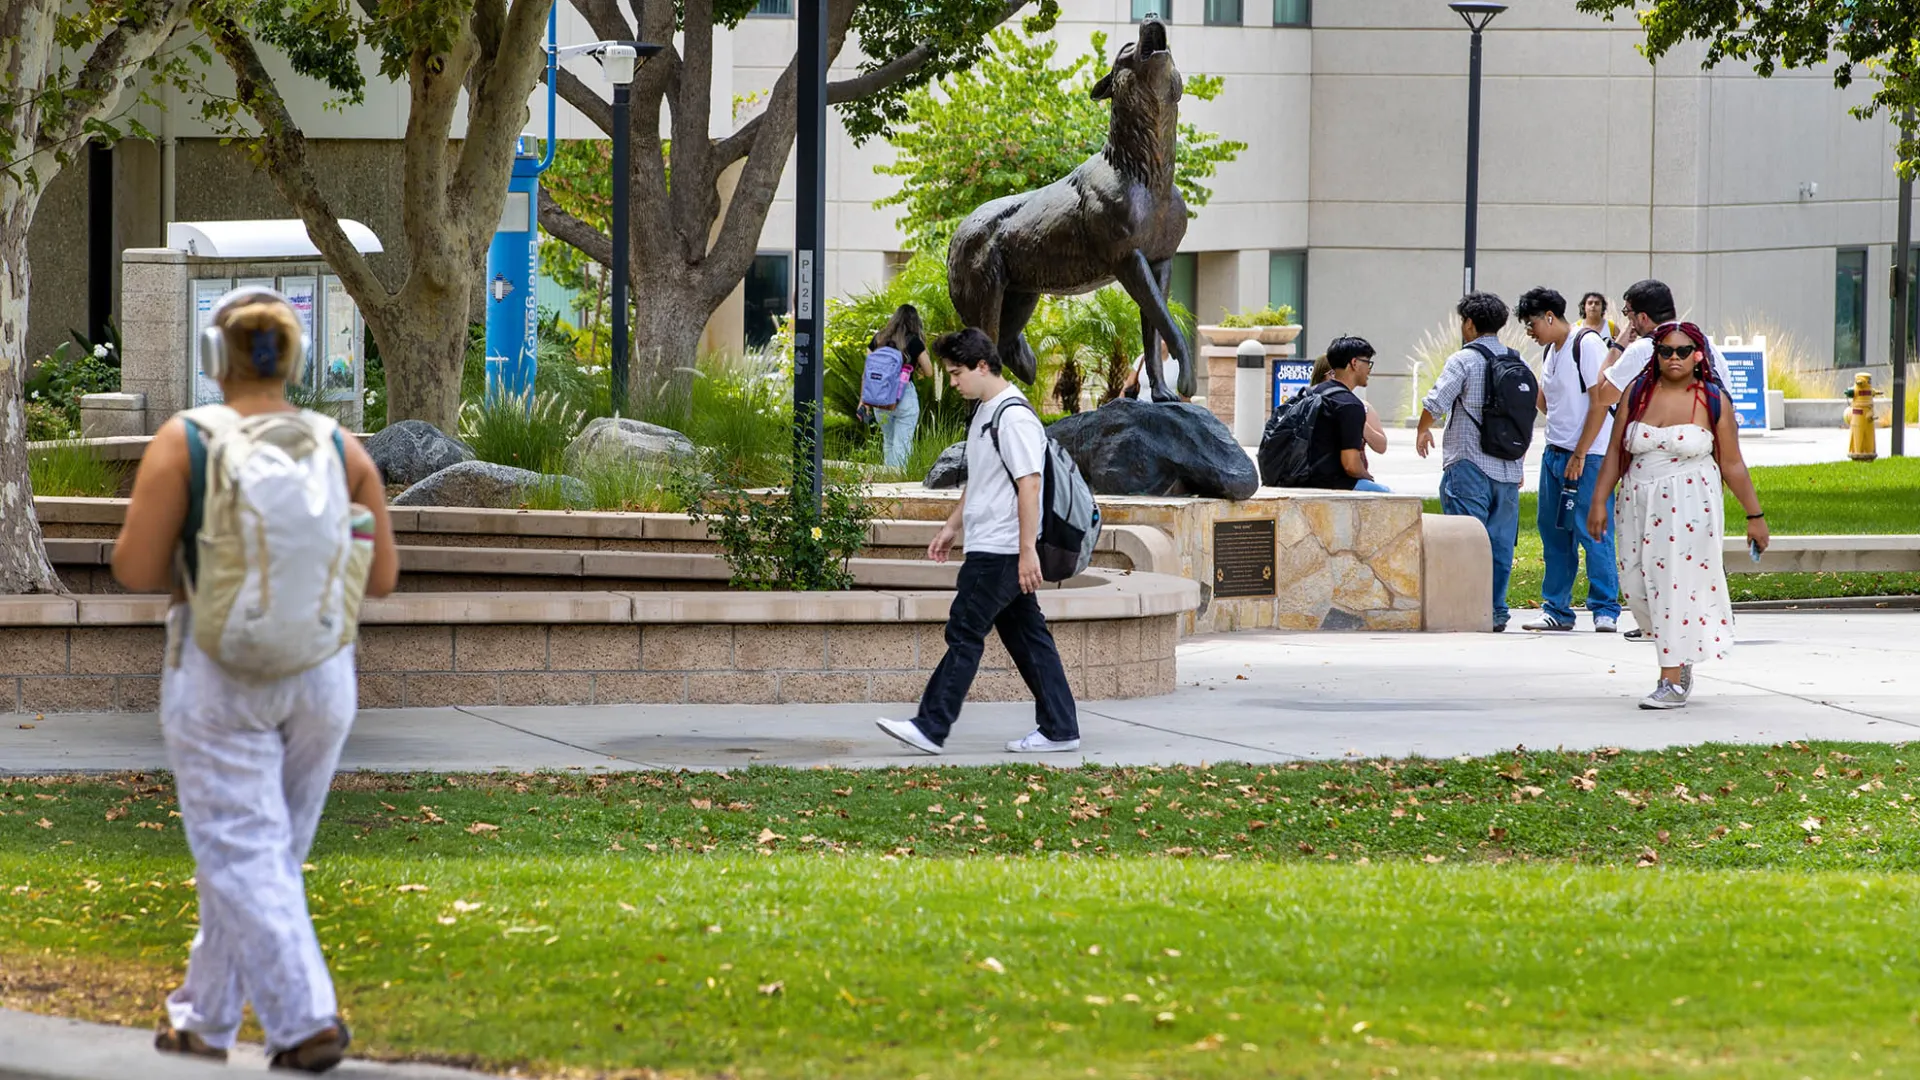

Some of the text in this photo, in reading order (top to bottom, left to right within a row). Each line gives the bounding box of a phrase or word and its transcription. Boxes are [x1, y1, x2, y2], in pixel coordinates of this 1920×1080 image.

[525, 240, 537, 359] Emergency
[1280, 365, 1307, 373] HOURS
[1278, 371, 1312, 380] OPERATI
